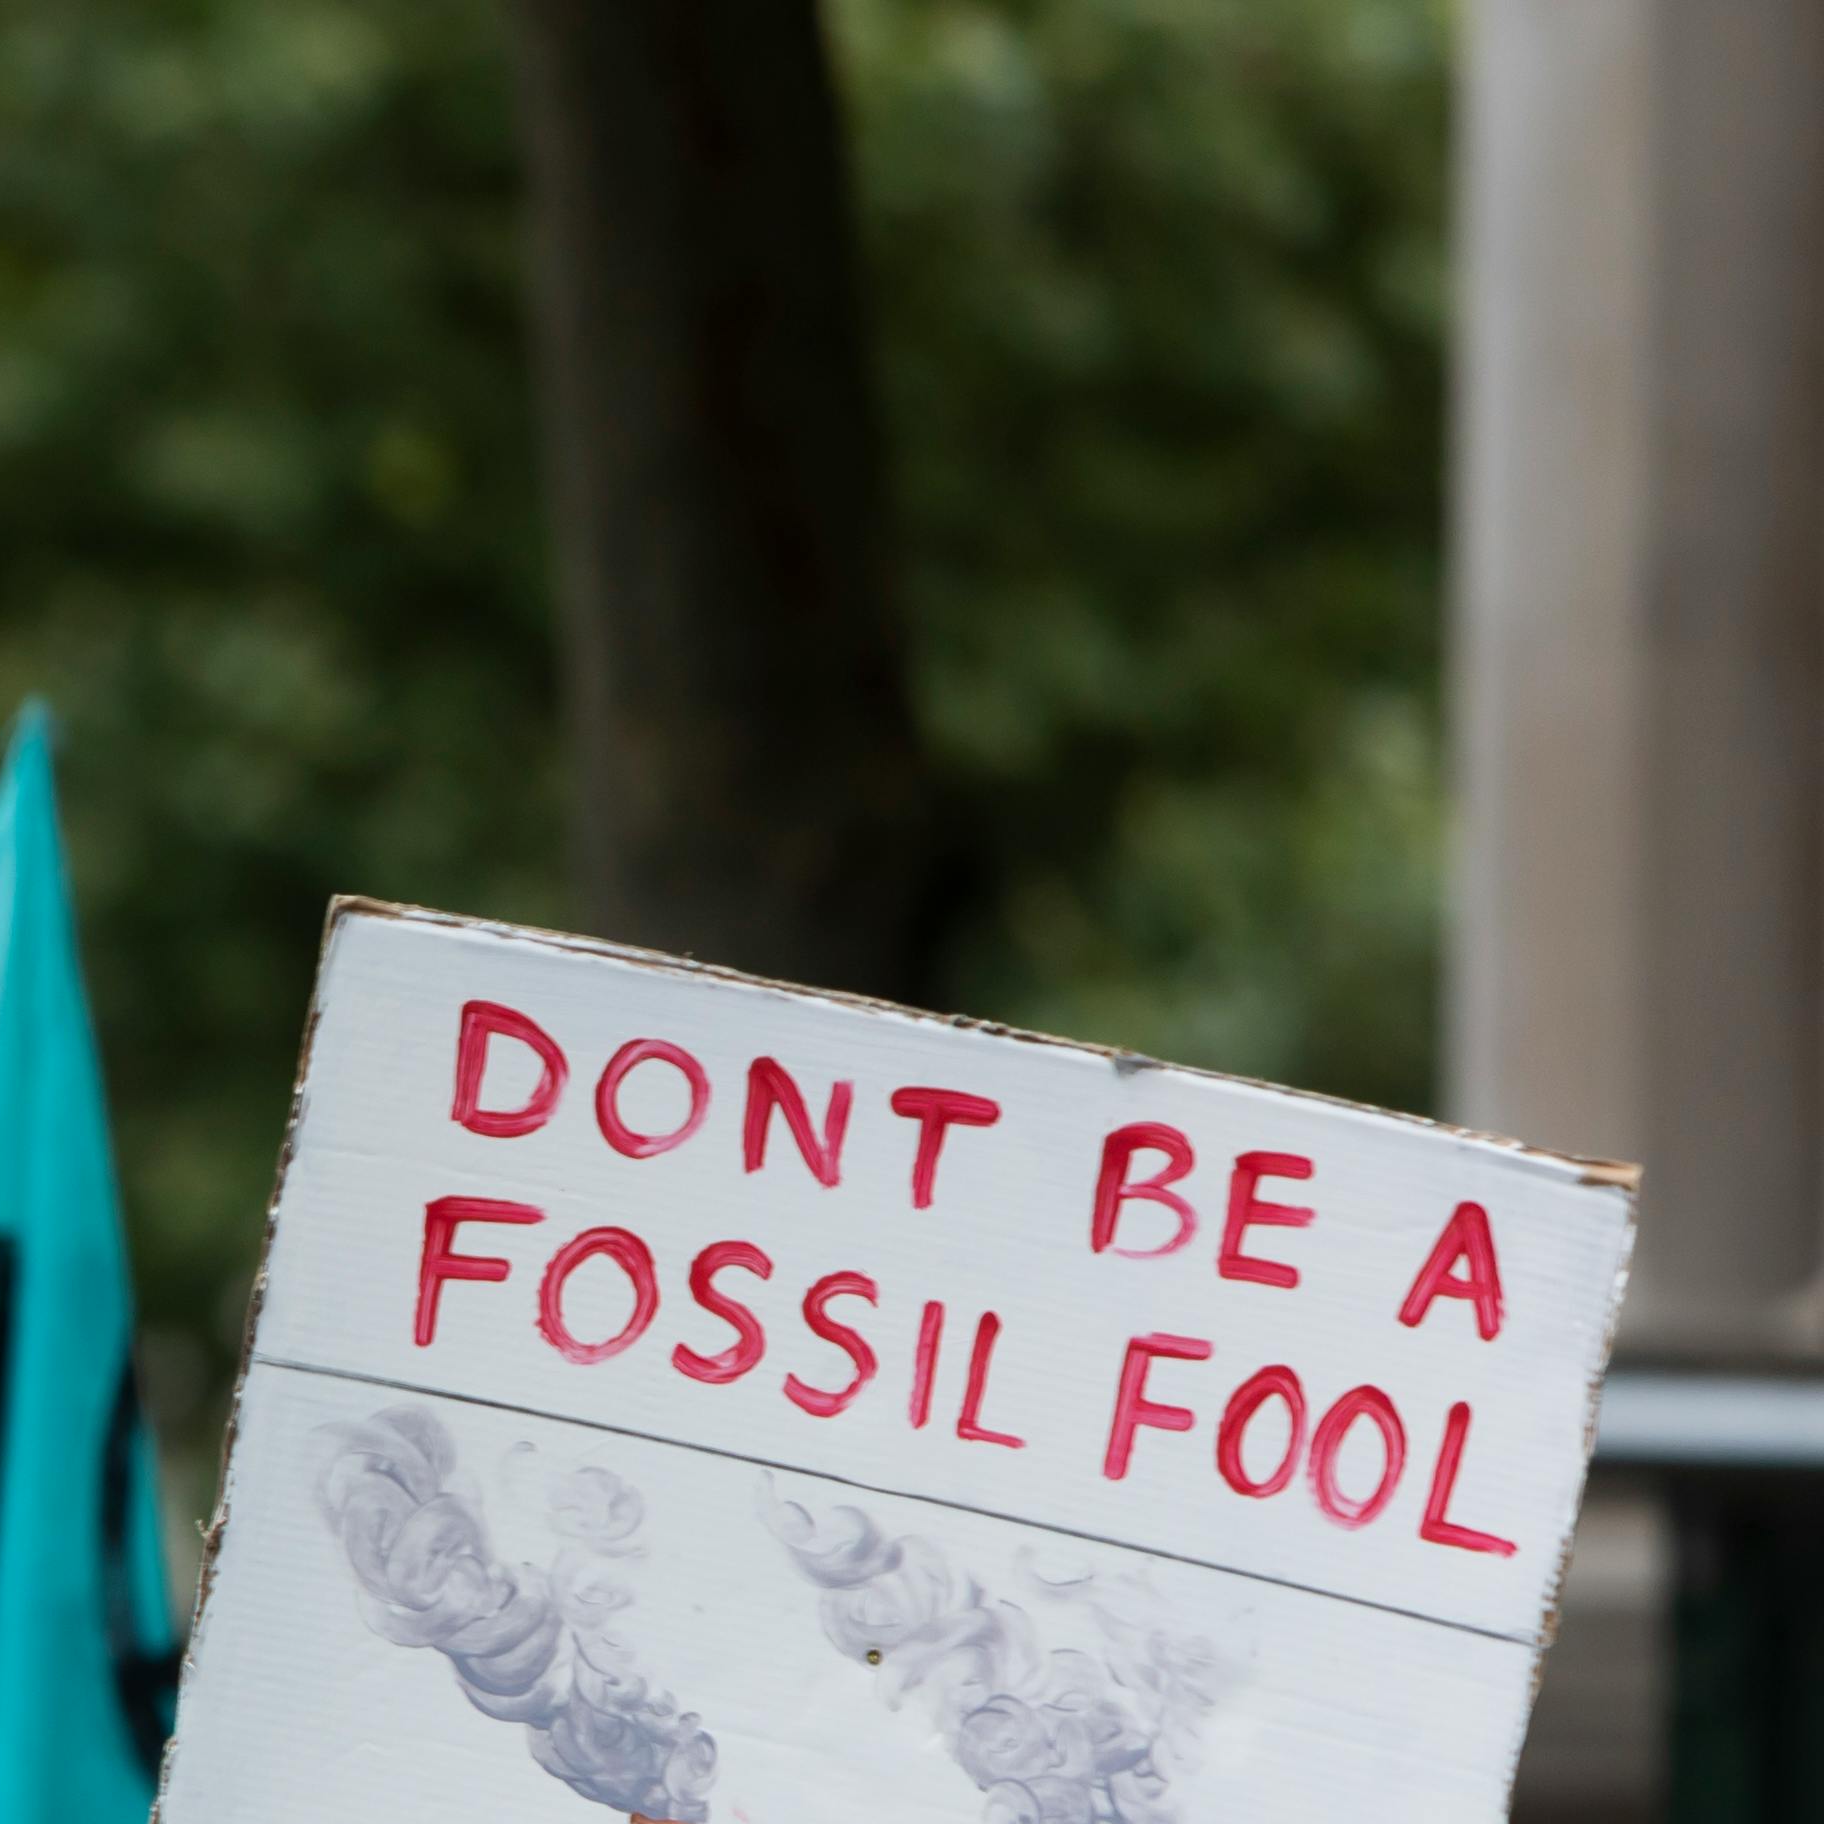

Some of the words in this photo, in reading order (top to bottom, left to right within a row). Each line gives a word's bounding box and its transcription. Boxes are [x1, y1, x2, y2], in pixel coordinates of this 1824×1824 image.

[450, 999, 1003, 1212] DONT
[1090, 1121, 1317, 1291] BE
[1396, 1199, 1506, 1343] A
[413, 1194, 1026, 1450] FOSSIL
[1102, 1332, 1519, 1560] FOOL
